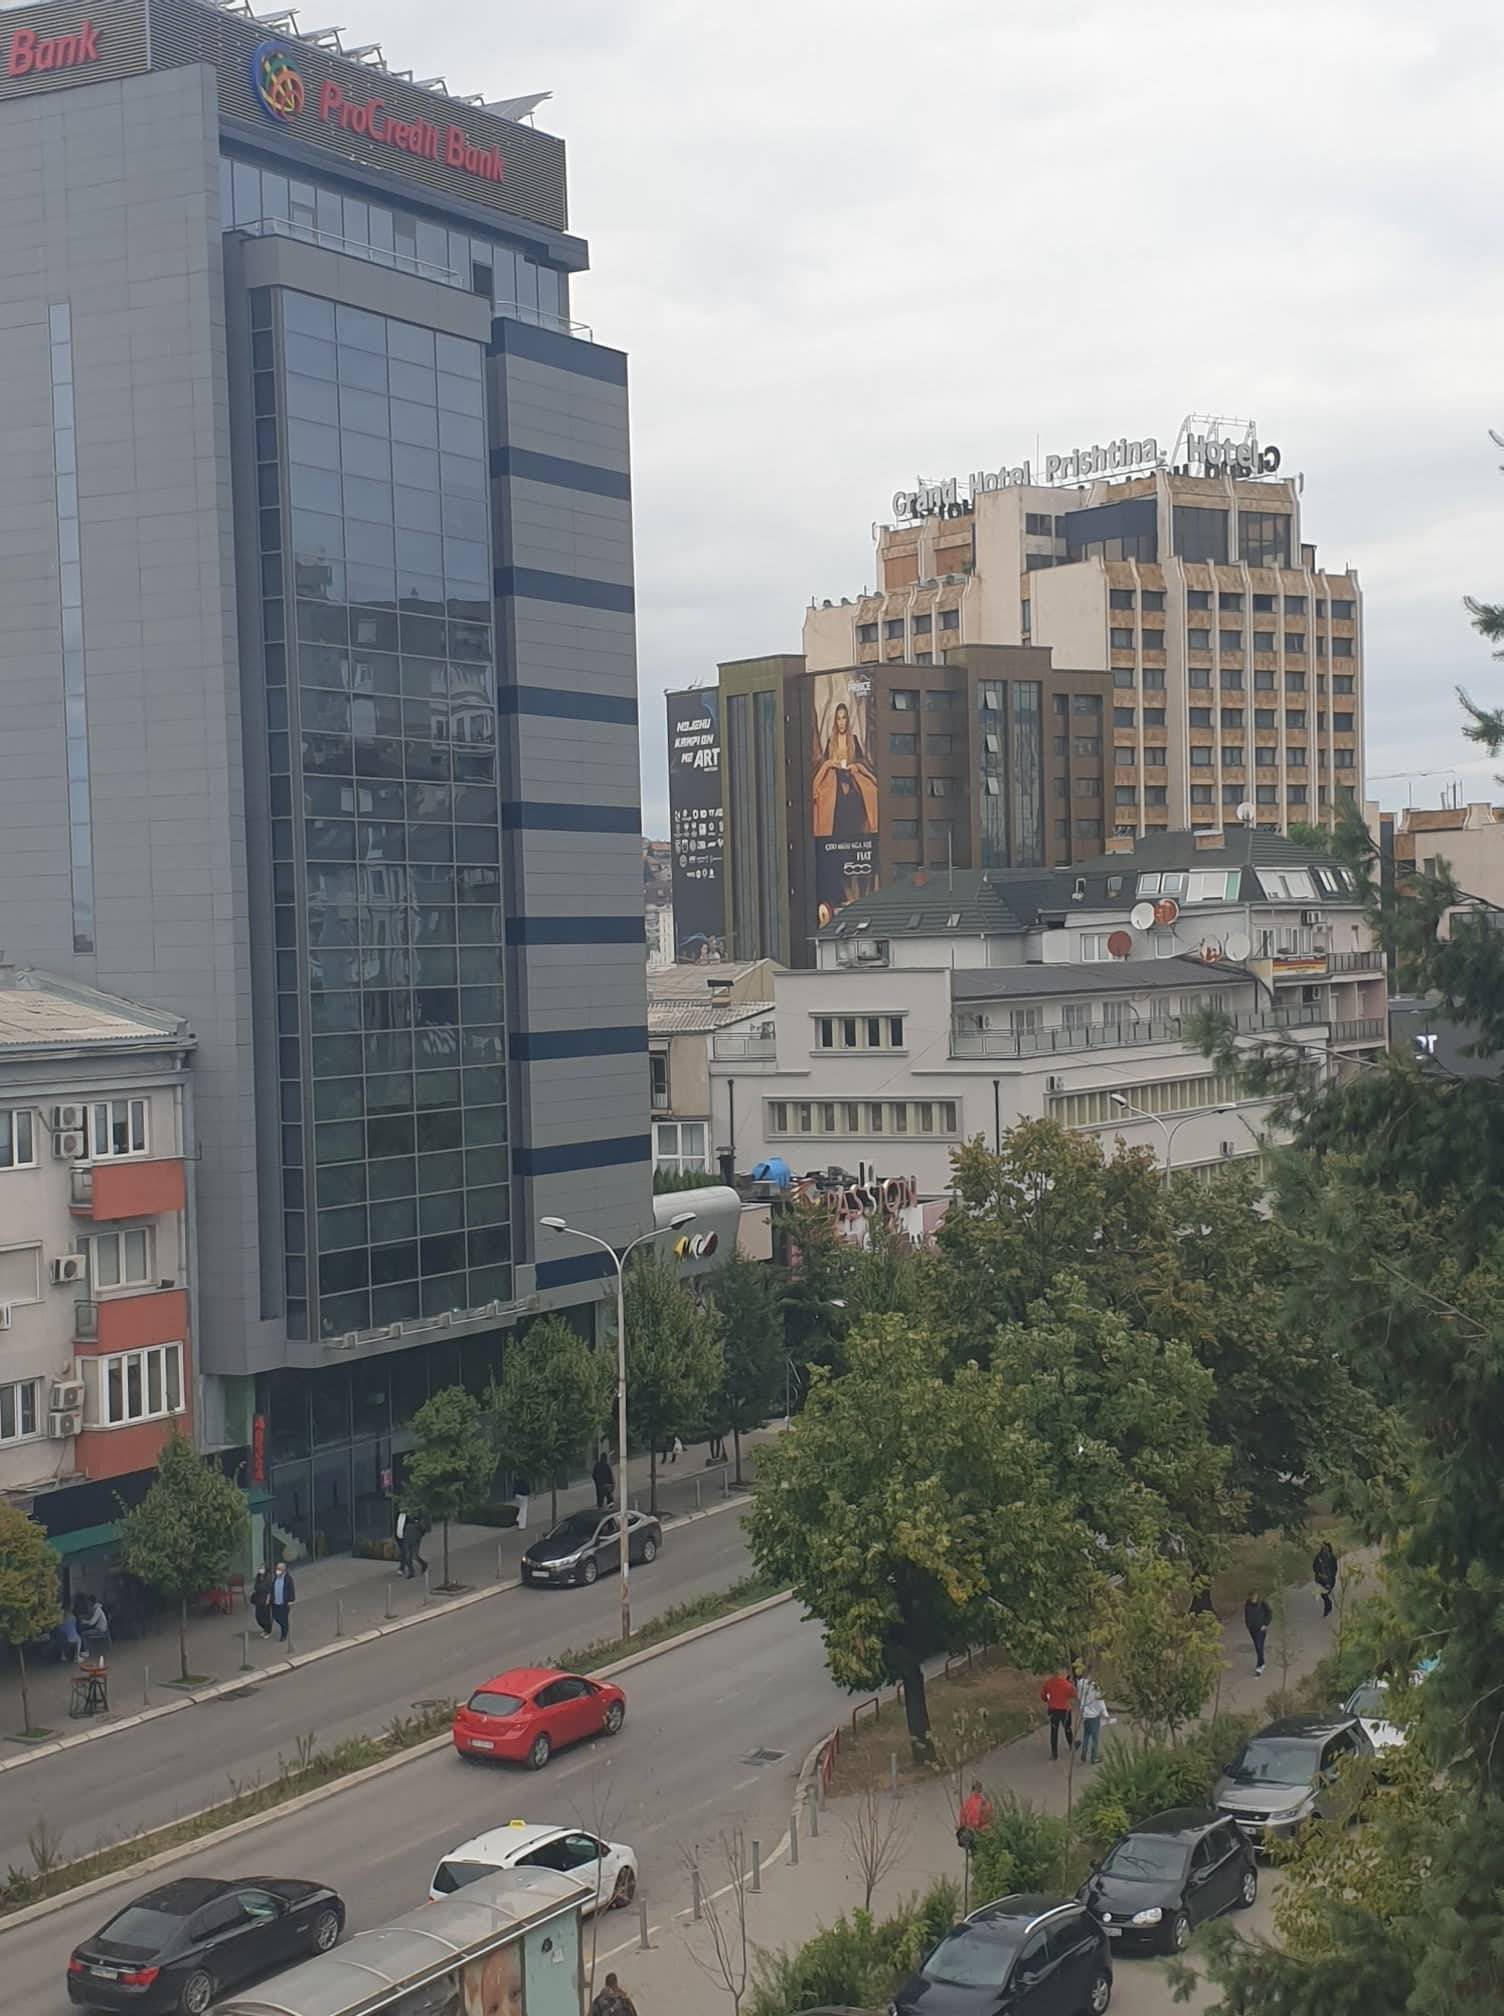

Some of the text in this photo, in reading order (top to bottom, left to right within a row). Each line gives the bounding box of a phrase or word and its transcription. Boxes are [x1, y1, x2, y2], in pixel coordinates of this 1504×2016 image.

[8, 19, 101, 77] Bank
[319, 79, 505, 184] ProCredit Bank
[1187, 433, 1259, 468] Hotel
[893, 478, 957, 516] Grand
[969, 460, 1031, 499] Hotel
[1046, 438, 1157, 483] Prishtina
[693, 747, 721, 768] ART
[843, 862, 872, 875] 500
